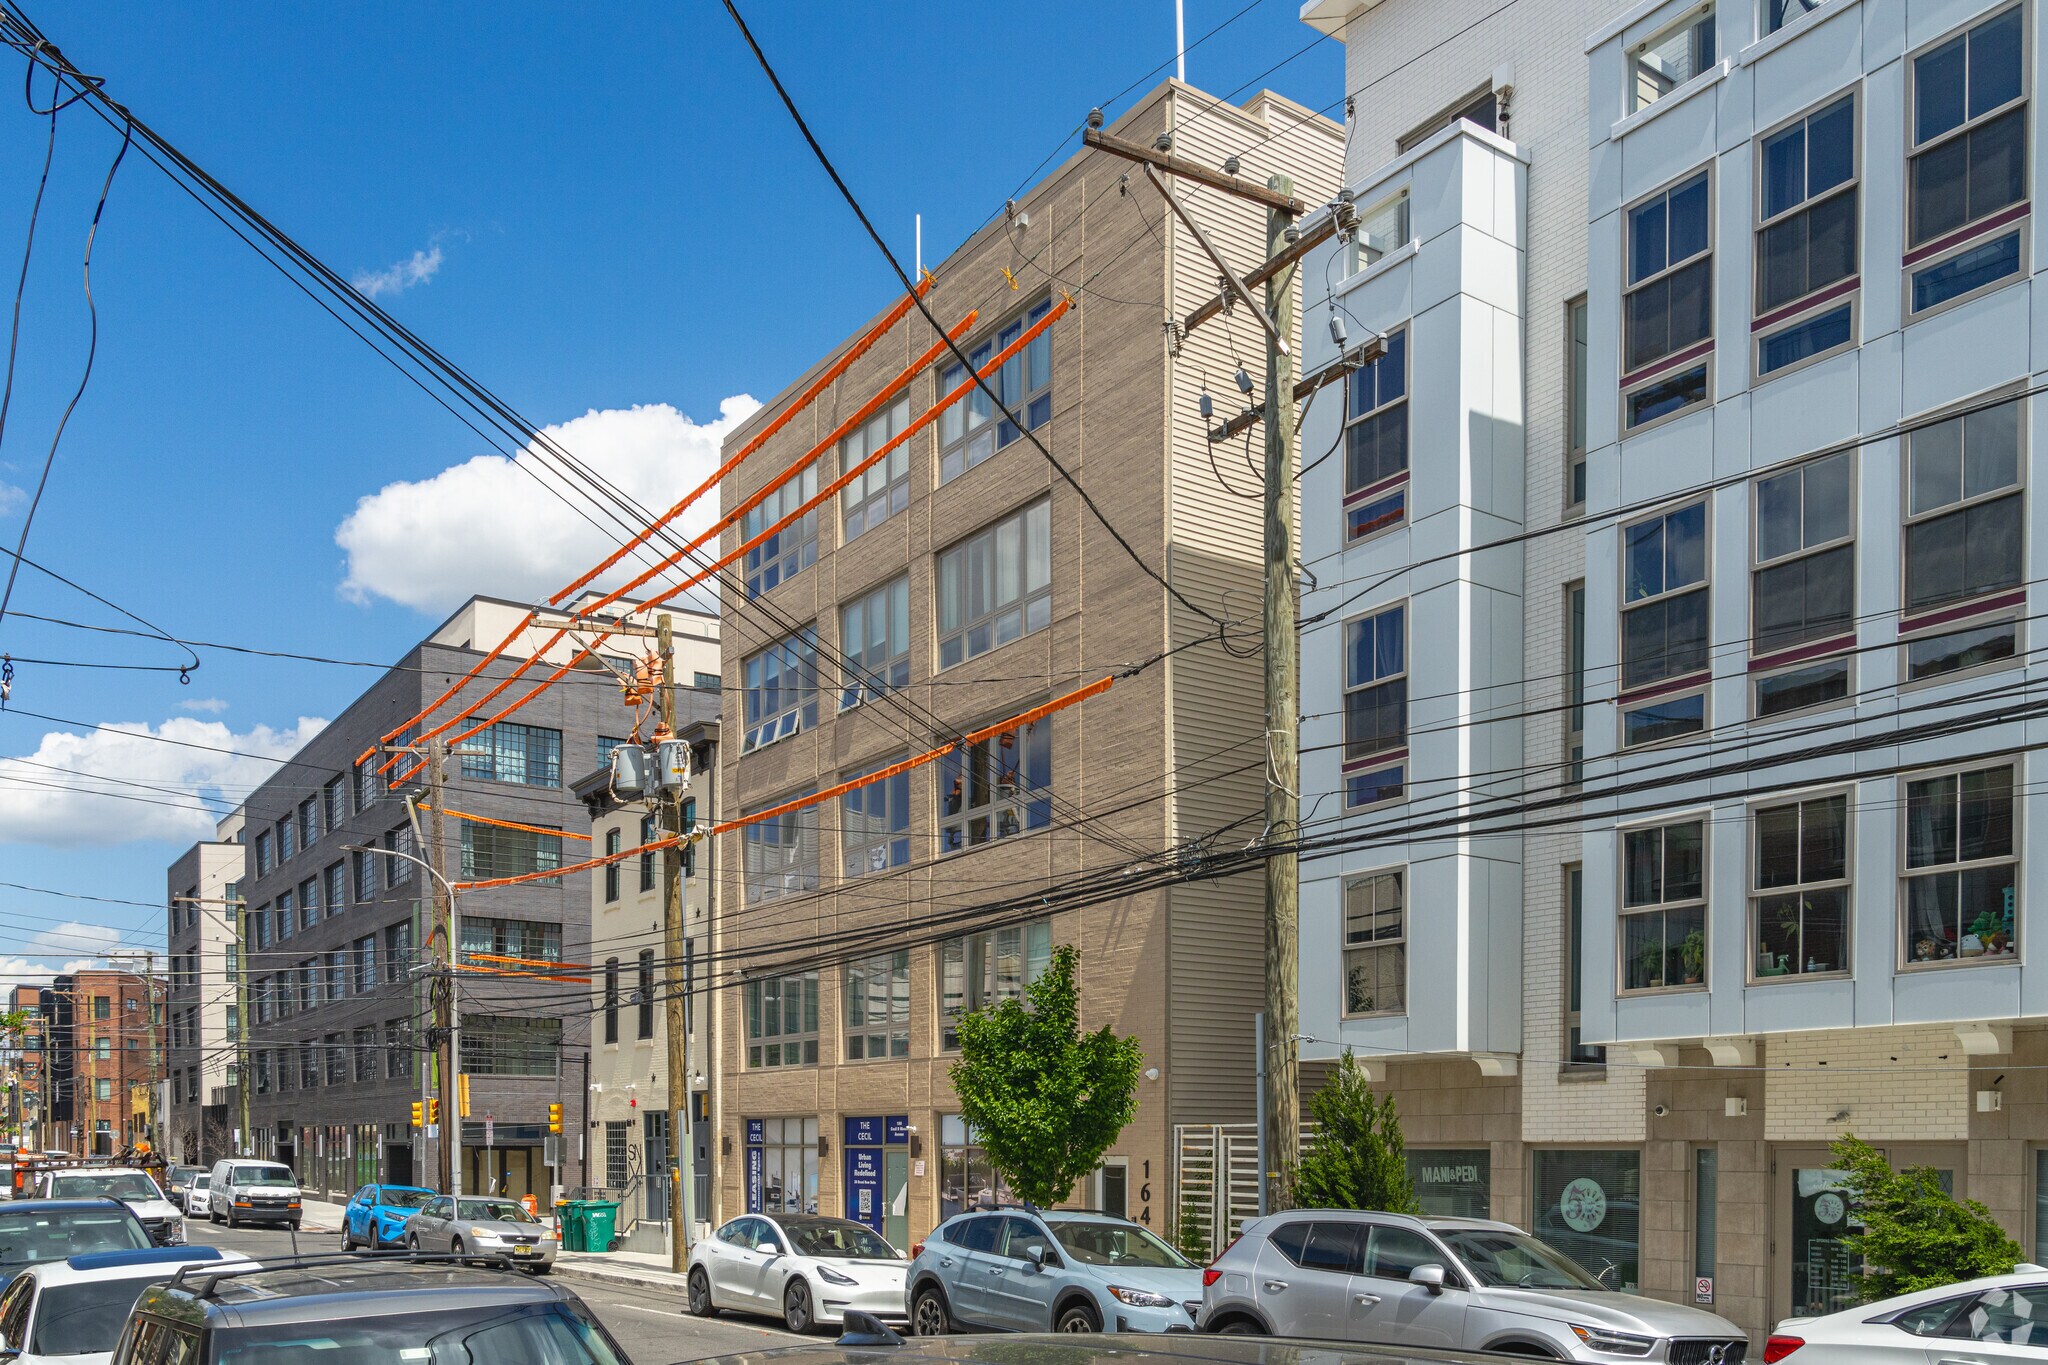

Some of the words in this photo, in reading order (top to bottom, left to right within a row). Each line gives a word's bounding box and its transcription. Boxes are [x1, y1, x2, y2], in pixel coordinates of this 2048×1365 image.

[752, 1123, 761, 1131] THE
[860, 1122, 870, 1130] THE
[750, 1134, 762, 1142] CECIL
[1422, 1166, 1478, 1182] MANI&PEDI
